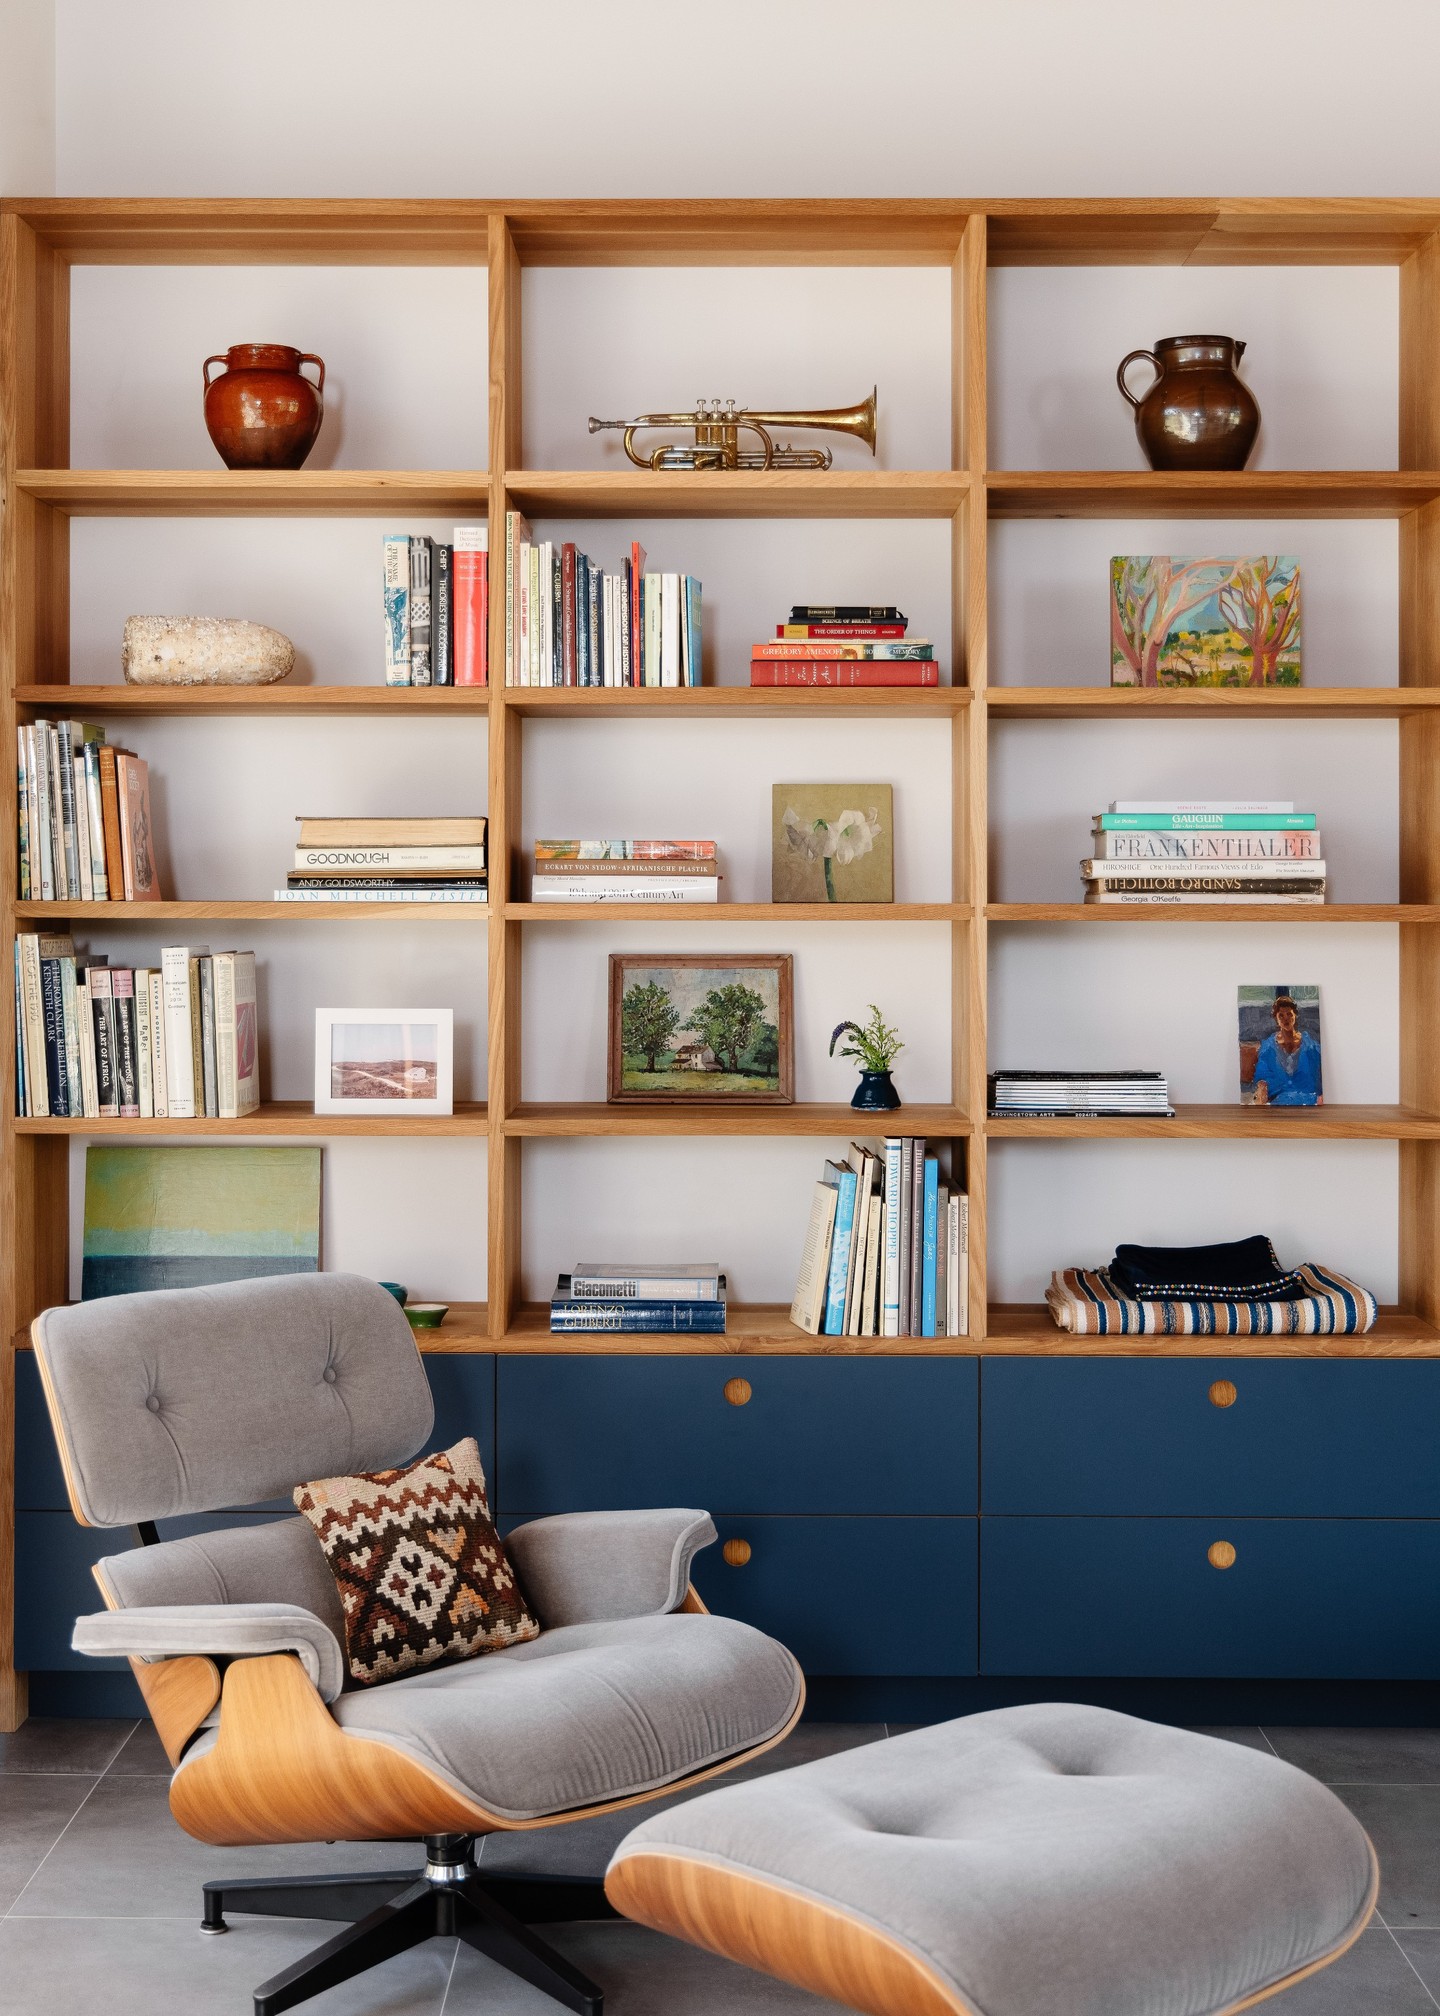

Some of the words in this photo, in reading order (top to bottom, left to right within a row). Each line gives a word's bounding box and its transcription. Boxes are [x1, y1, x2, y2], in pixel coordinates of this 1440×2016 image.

[387, 544, 392, 553] OF
[530, 571, 538, 596] Organic
[589, 579, 597, 602] Creighton
[439, 614, 446, 624] OF
[438, 625, 447, 657] MODERN
[622, 635, 628, 645] OF
[58, 733, 72, 765] DYNAMIC
[60, 766, 74, 792] FIGURE
[62, 793, 76, 825] DRAWING
[1172, 814, 1223, 823] GAUGUIN
[1113, 838, 1313, 858] FRANKENTHALER
[306, 852, 390, 865] GOODNOUGH
[298, 879, 323, 887] ANDY
[325, 879, 395, 887] GOLDSWORTHY
[1103, 878, 1176, 890] BOTTICELLI
[1180, 878, 1242, 890] SANDRO
[277, 891, 319, 901] JOAN
[330, 892, 418, 900] MITCHELL
[630, 887, 667, 901] Century
[668, 890, 684, 899] Art
[1121, 896, 1148, 904] Georgia
[1151, 895, 1181, 903] O'Keeffe
[26, 945, 36, 965] ART
[27, 967, 35, 979] OF
[52, 965, 60, 985] THE
[28, 982, 37, 1001] THE
[42, 966, 54, 1010] KENNETH
[53, 986, 64, 1037] ROMANTIC
[45, 1012, 56, 1043] CLARK
[123, 1035, 129, 1046] OF
[139, 1025, 148, 1053] BABEL
[101, 1047, 108, 1058] OF
[57, 1038, 67, 1087] REBELLION
[915, 1149, 923, 1166] FRIDA
[888, 1154, 899, 1208] EDWARD
[915, 1167, 923, 1184] KAHLO
[927, 1191, 936, 1214] Henri
[887, 1211, 898, 1260] HOPPER
[960, 1222, 968, 1254] Motherwell
[938, 1249, 944, 1261] ON
[573, 1280, 636, 1298] Giacometti
[564, 1305, 625, 1313] LORENZO
[831, 1306, 839, 1329] Abbeville
[564, 1318, 623, 1328] GHIBERTI
